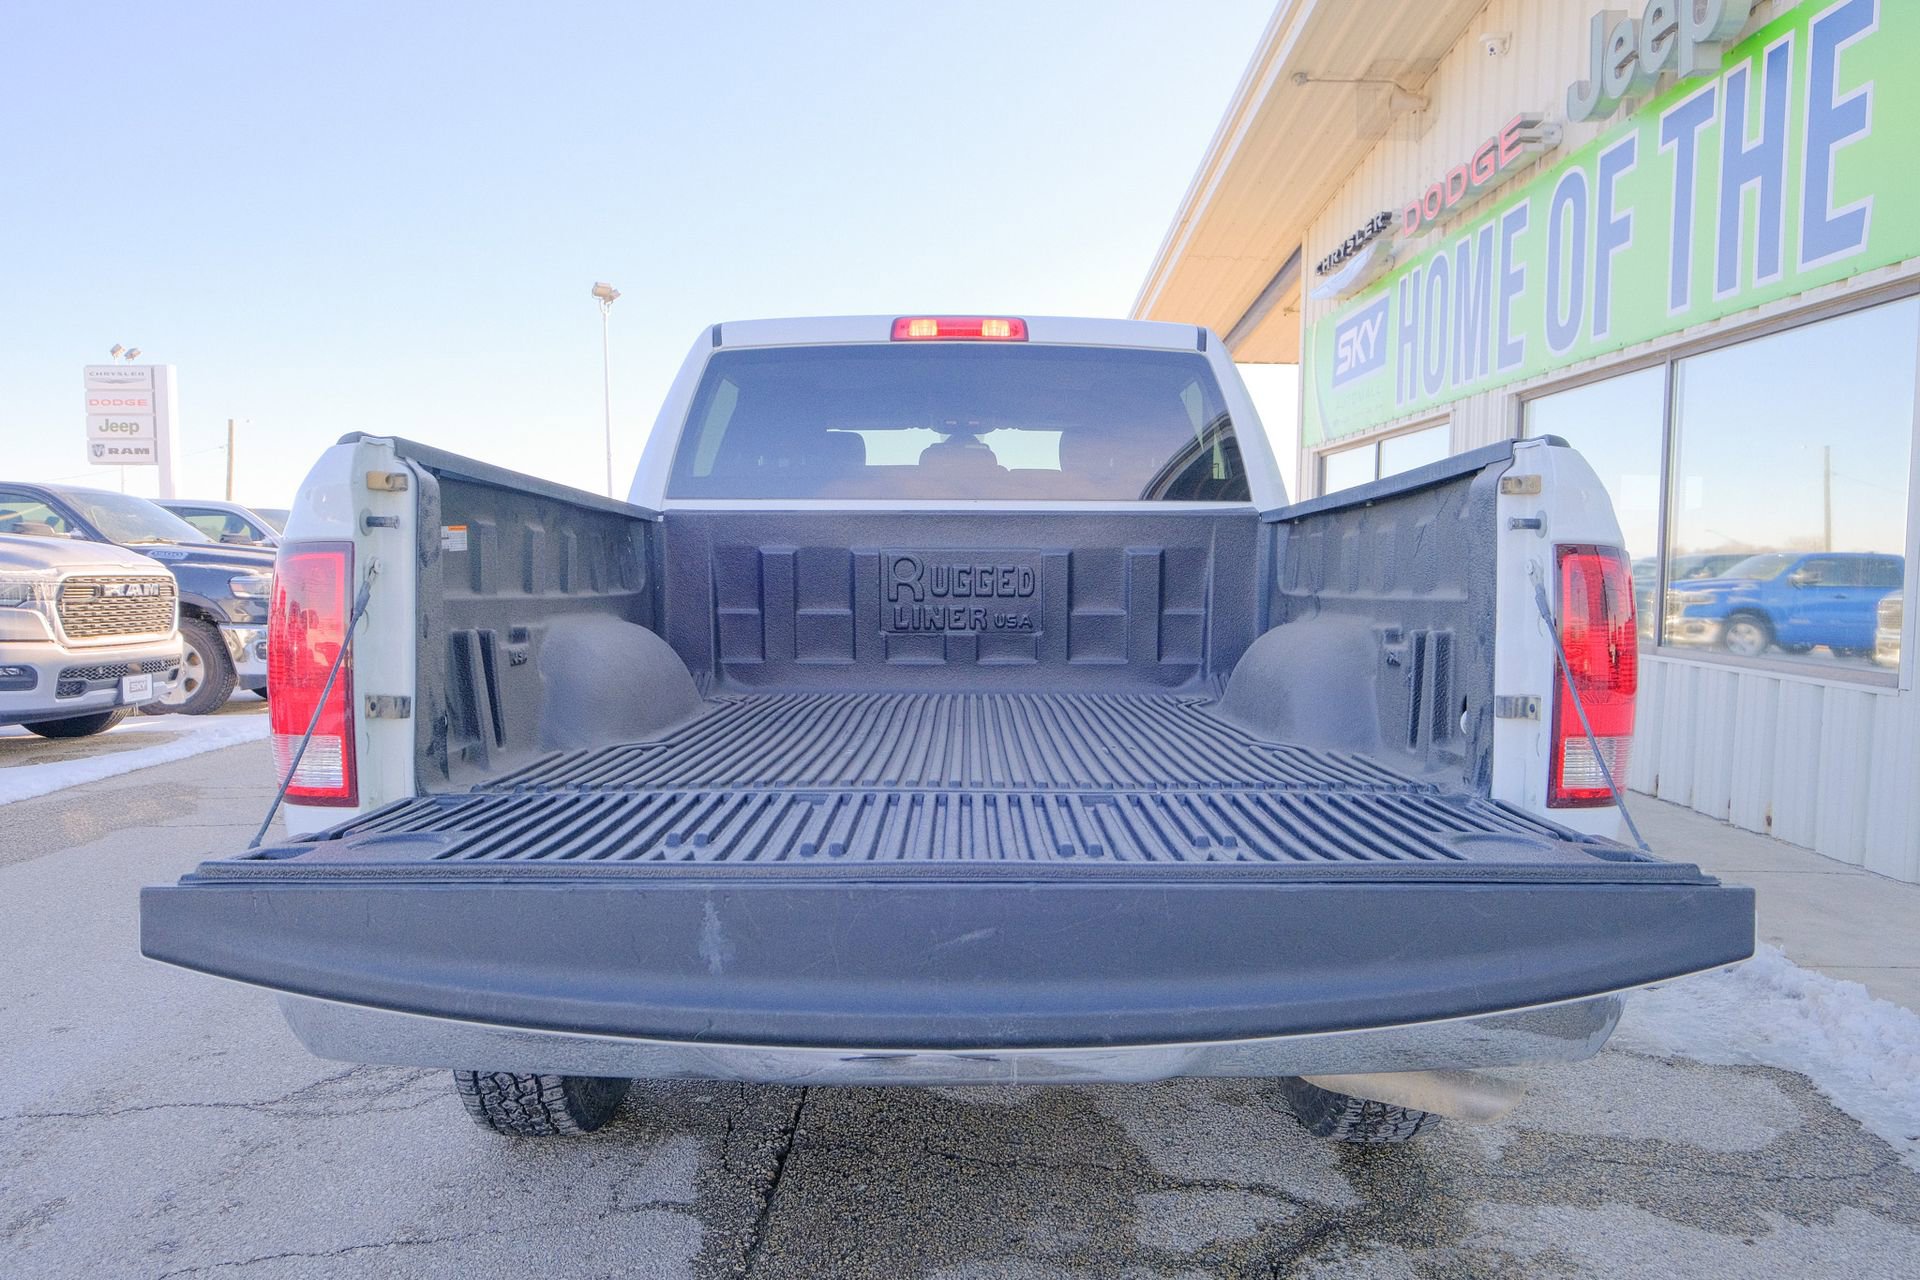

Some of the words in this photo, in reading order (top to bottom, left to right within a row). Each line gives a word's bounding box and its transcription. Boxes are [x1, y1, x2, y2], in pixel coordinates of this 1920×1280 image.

[1566, 0, 1728, 123] Jeep
[1404, 113, 1524, 238] DODGE
[1396, 197, 1530, 408] HOME
[1546, 128, 1639, 356] OF
[1657, 0, 1880, 317] THE
[1316, 211, 1392, 275] CHRYSLER
[1335, 310, 1384, 377] SKY
[88, 399, 148, 407] DODGE
[98, 418, 140, 435] Jeep
[108, 447, 150, 455] RAM
[102, 583, 160, 598] RAM
[887, 553, 1036, 602] RUGGED
[893, 604, 988, 631] LINER
[993, 612, 1034, 629] USA
